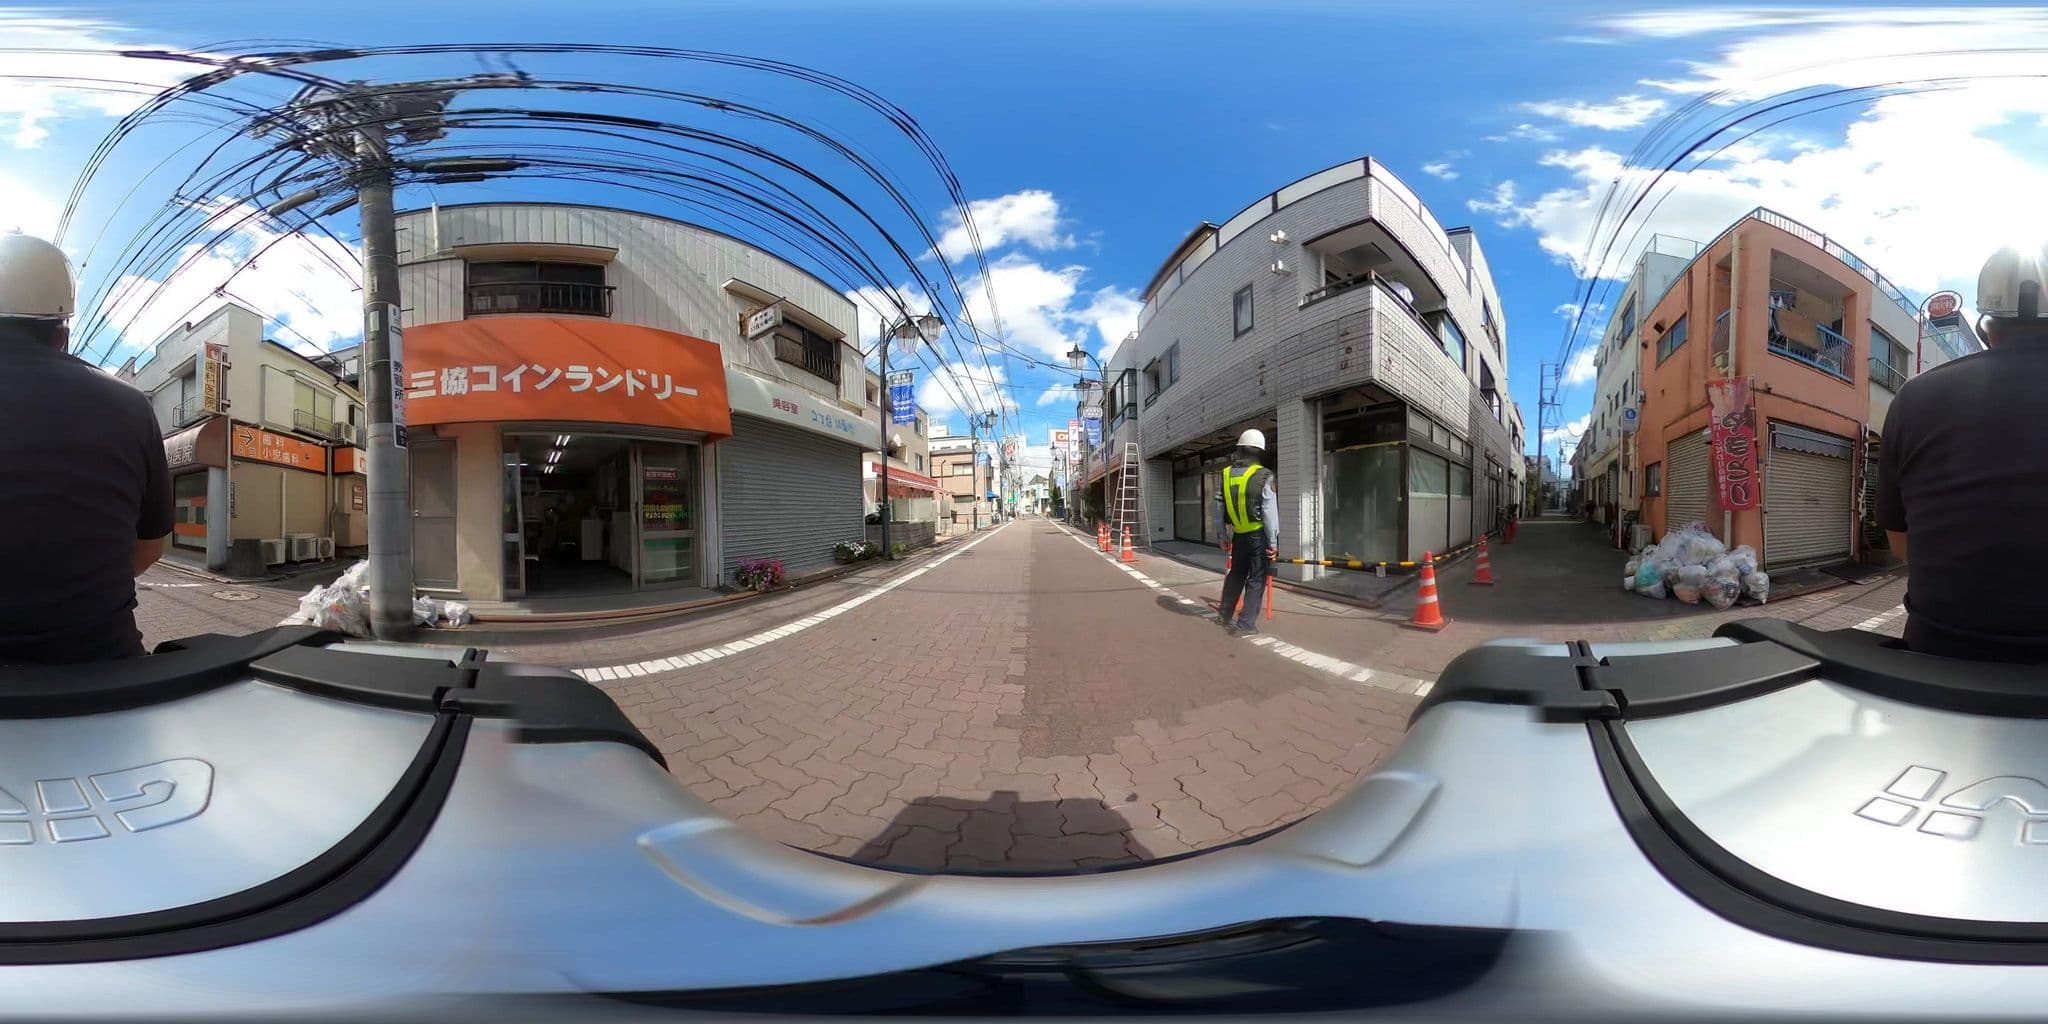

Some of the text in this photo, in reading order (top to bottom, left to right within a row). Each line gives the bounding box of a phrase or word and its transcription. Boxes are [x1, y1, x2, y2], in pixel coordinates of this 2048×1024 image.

[408, 364, 698, 400] 三協コインランドリー
[772, 398, 799, 415] 美容室
[262, 433, 285, 448] 歯科
[263, 447, 299, 465] 小児歯科
